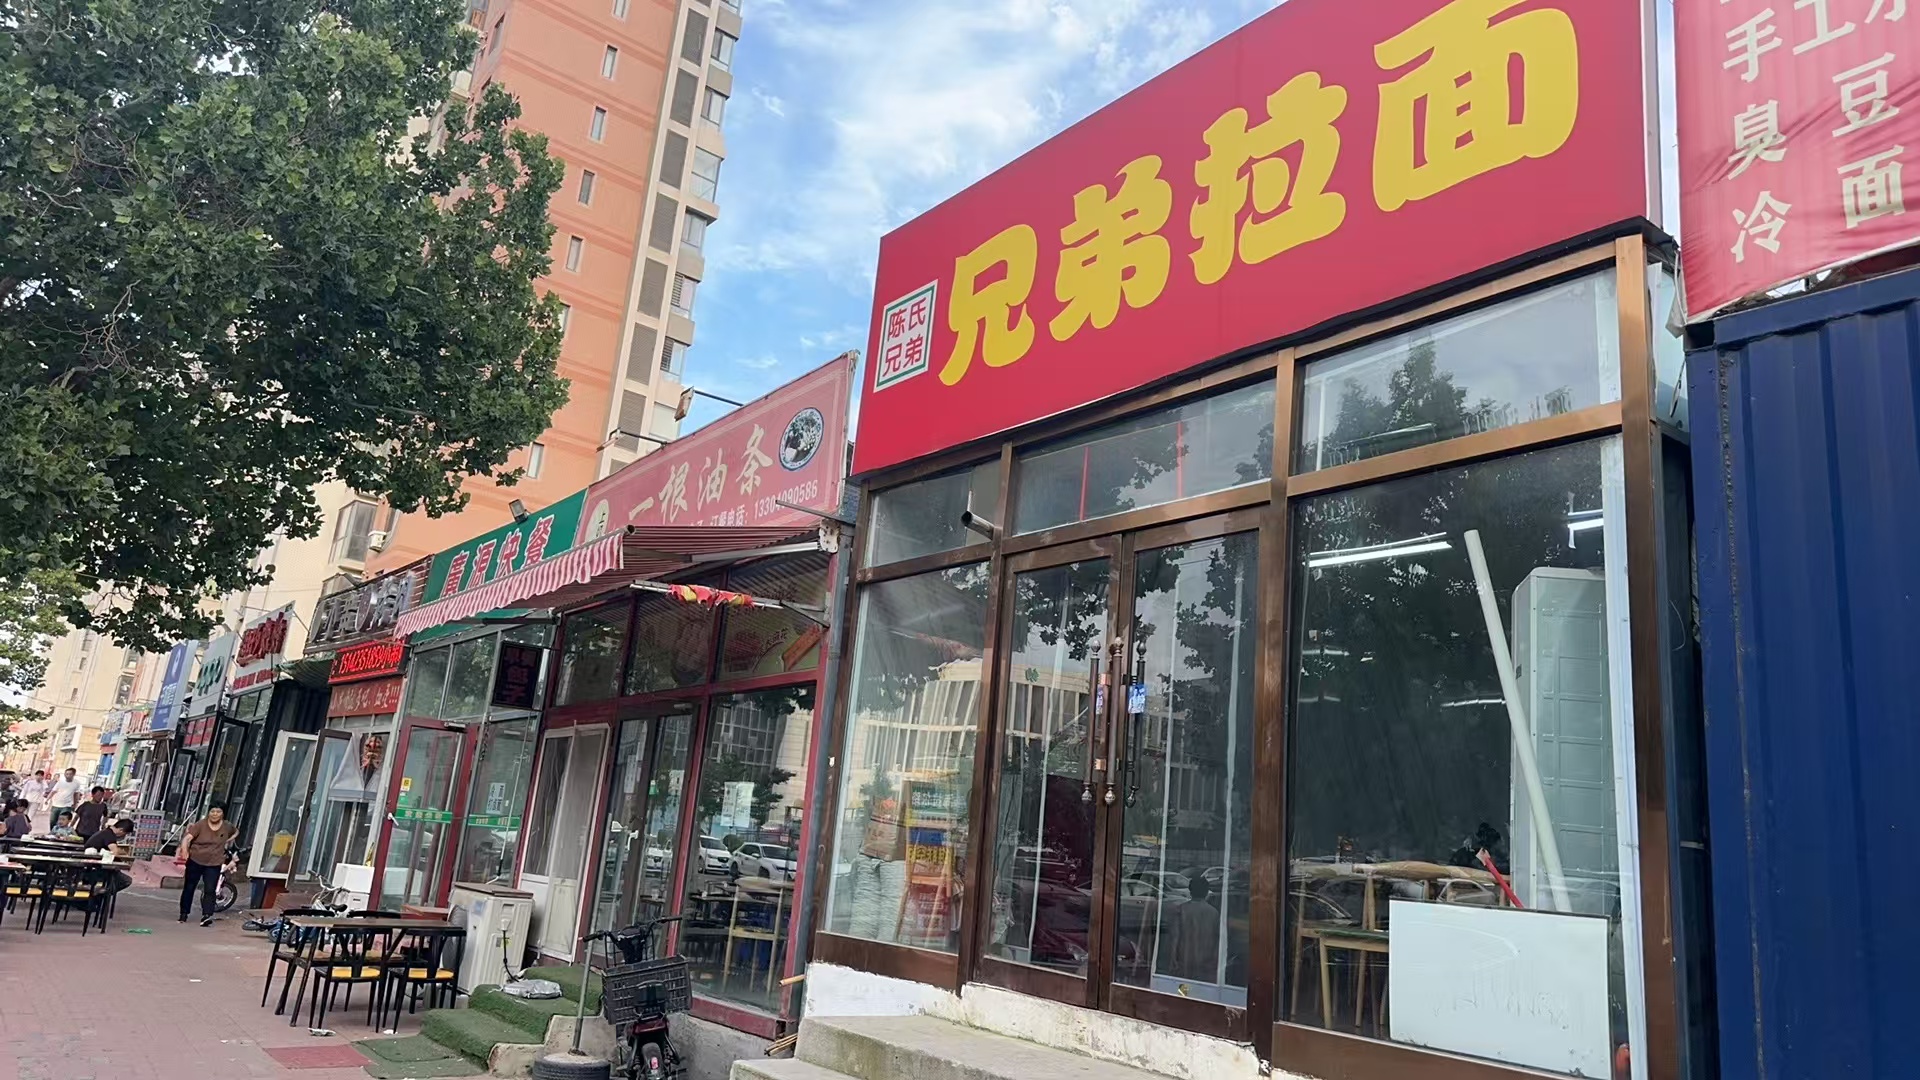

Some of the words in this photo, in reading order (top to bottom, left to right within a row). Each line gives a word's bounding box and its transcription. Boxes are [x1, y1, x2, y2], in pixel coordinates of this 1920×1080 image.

[1727, 52, 1901, 181] 臭豆
[939, 0, 1579, 386] 兄弟拉面
[1730, 144, 1906, 263] 冷面
[882, 334, 924, 377] 兄弟
[887, 297, 927, 342] 陈氏
[629, 424, 774, 523] 一根油条
